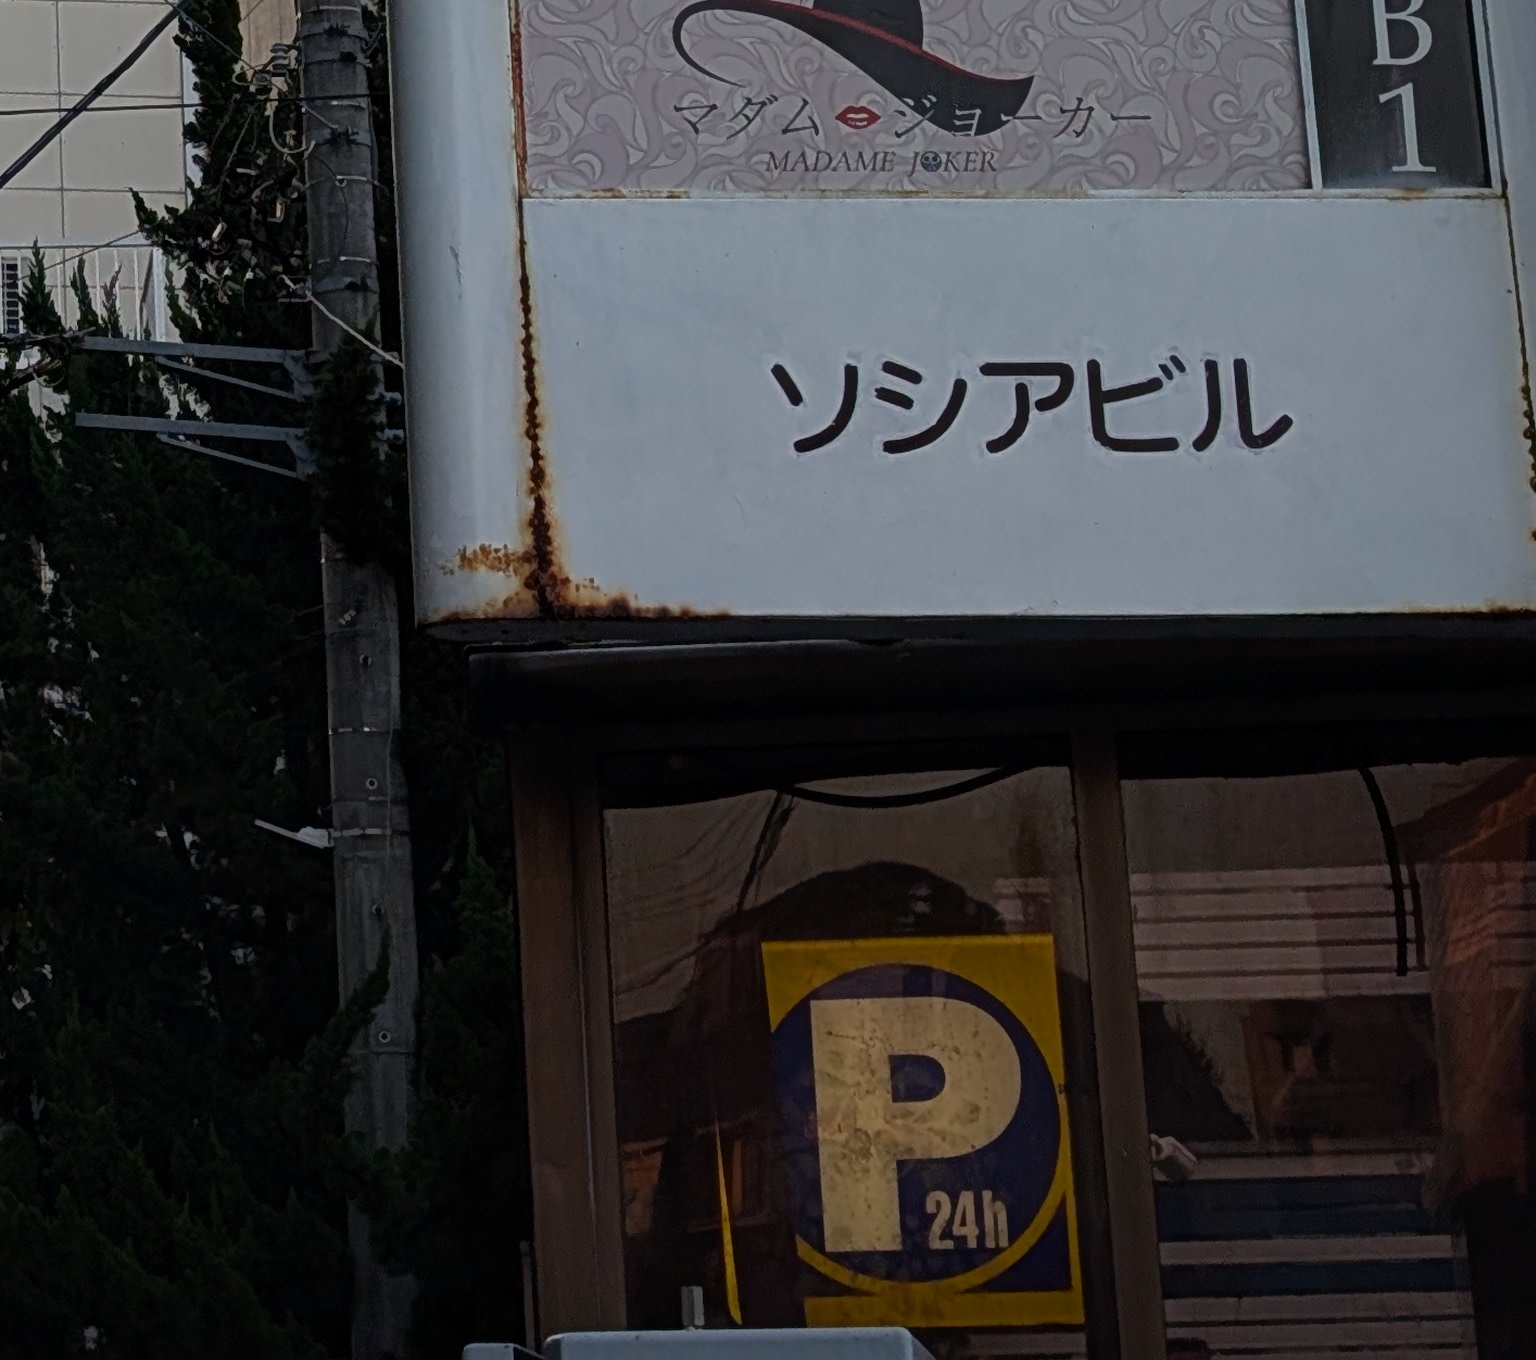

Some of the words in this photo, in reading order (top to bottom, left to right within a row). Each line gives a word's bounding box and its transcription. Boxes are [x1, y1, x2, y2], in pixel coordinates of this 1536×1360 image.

[672, 95, 820, 141] マダム
[893, 93, 1153, 140] ジョーカー
[763, 149, 896, 173] MADAME
[770, 353, 1295, 454] ソシアビル
[810, 996, 1023, 1253] P
[924, 1190, 1010, 1250] 24h
